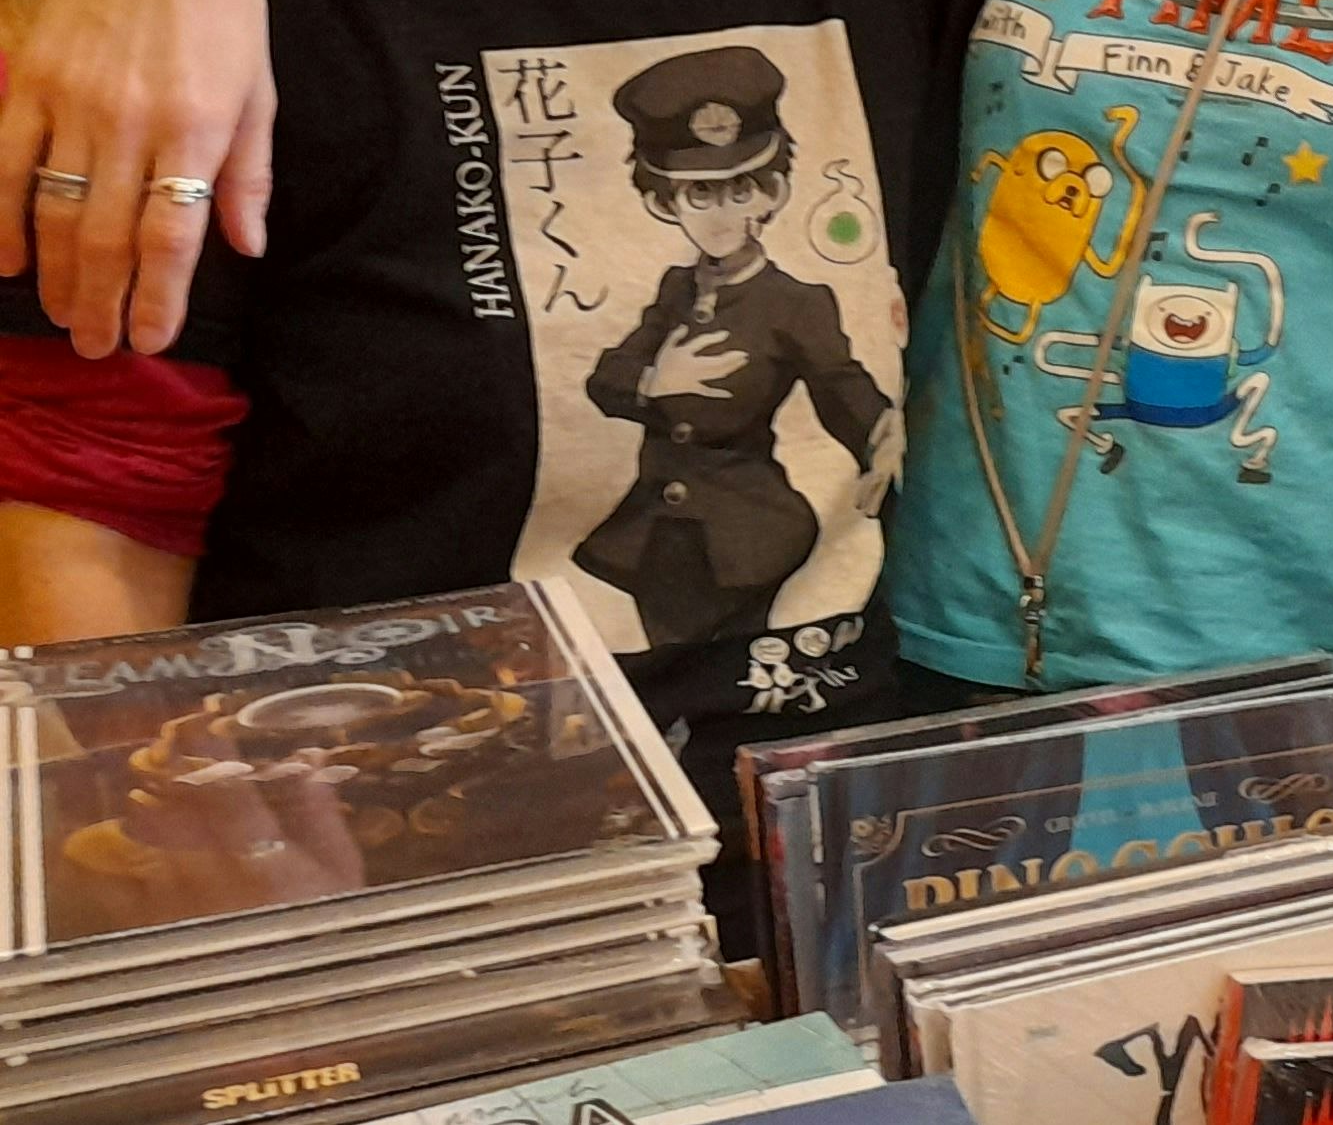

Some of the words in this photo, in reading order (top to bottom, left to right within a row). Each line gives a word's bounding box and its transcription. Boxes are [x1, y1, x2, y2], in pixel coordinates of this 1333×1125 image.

[435, 61, 517, 320] HANAKO-KUN
[497, 56, 608, 314] 花子くん
[1102, 43, 1172, 76] Finn
[1217, 59, 1292, 103] Jake
